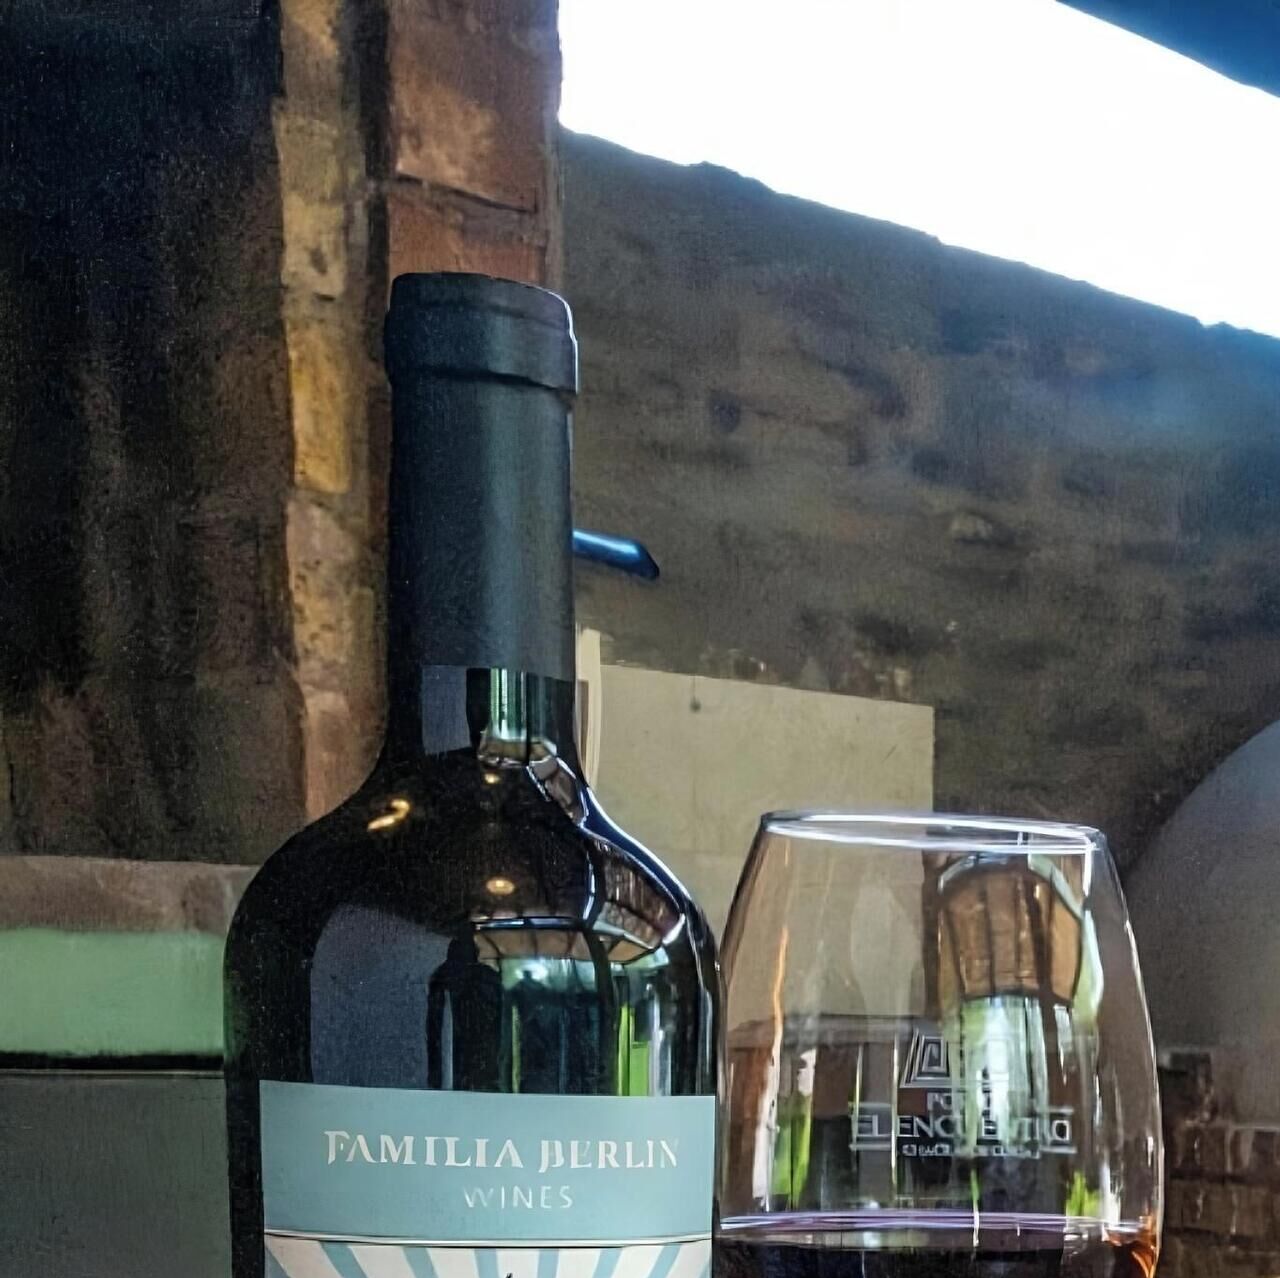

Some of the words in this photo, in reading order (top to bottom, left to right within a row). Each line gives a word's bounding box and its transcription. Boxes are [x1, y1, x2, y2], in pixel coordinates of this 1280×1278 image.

[324, 1130, 524, 1169] FAMILIA
[538, 1136, 679, 1173] BERLIN
[462, 1184, 573, 1210] WINES
